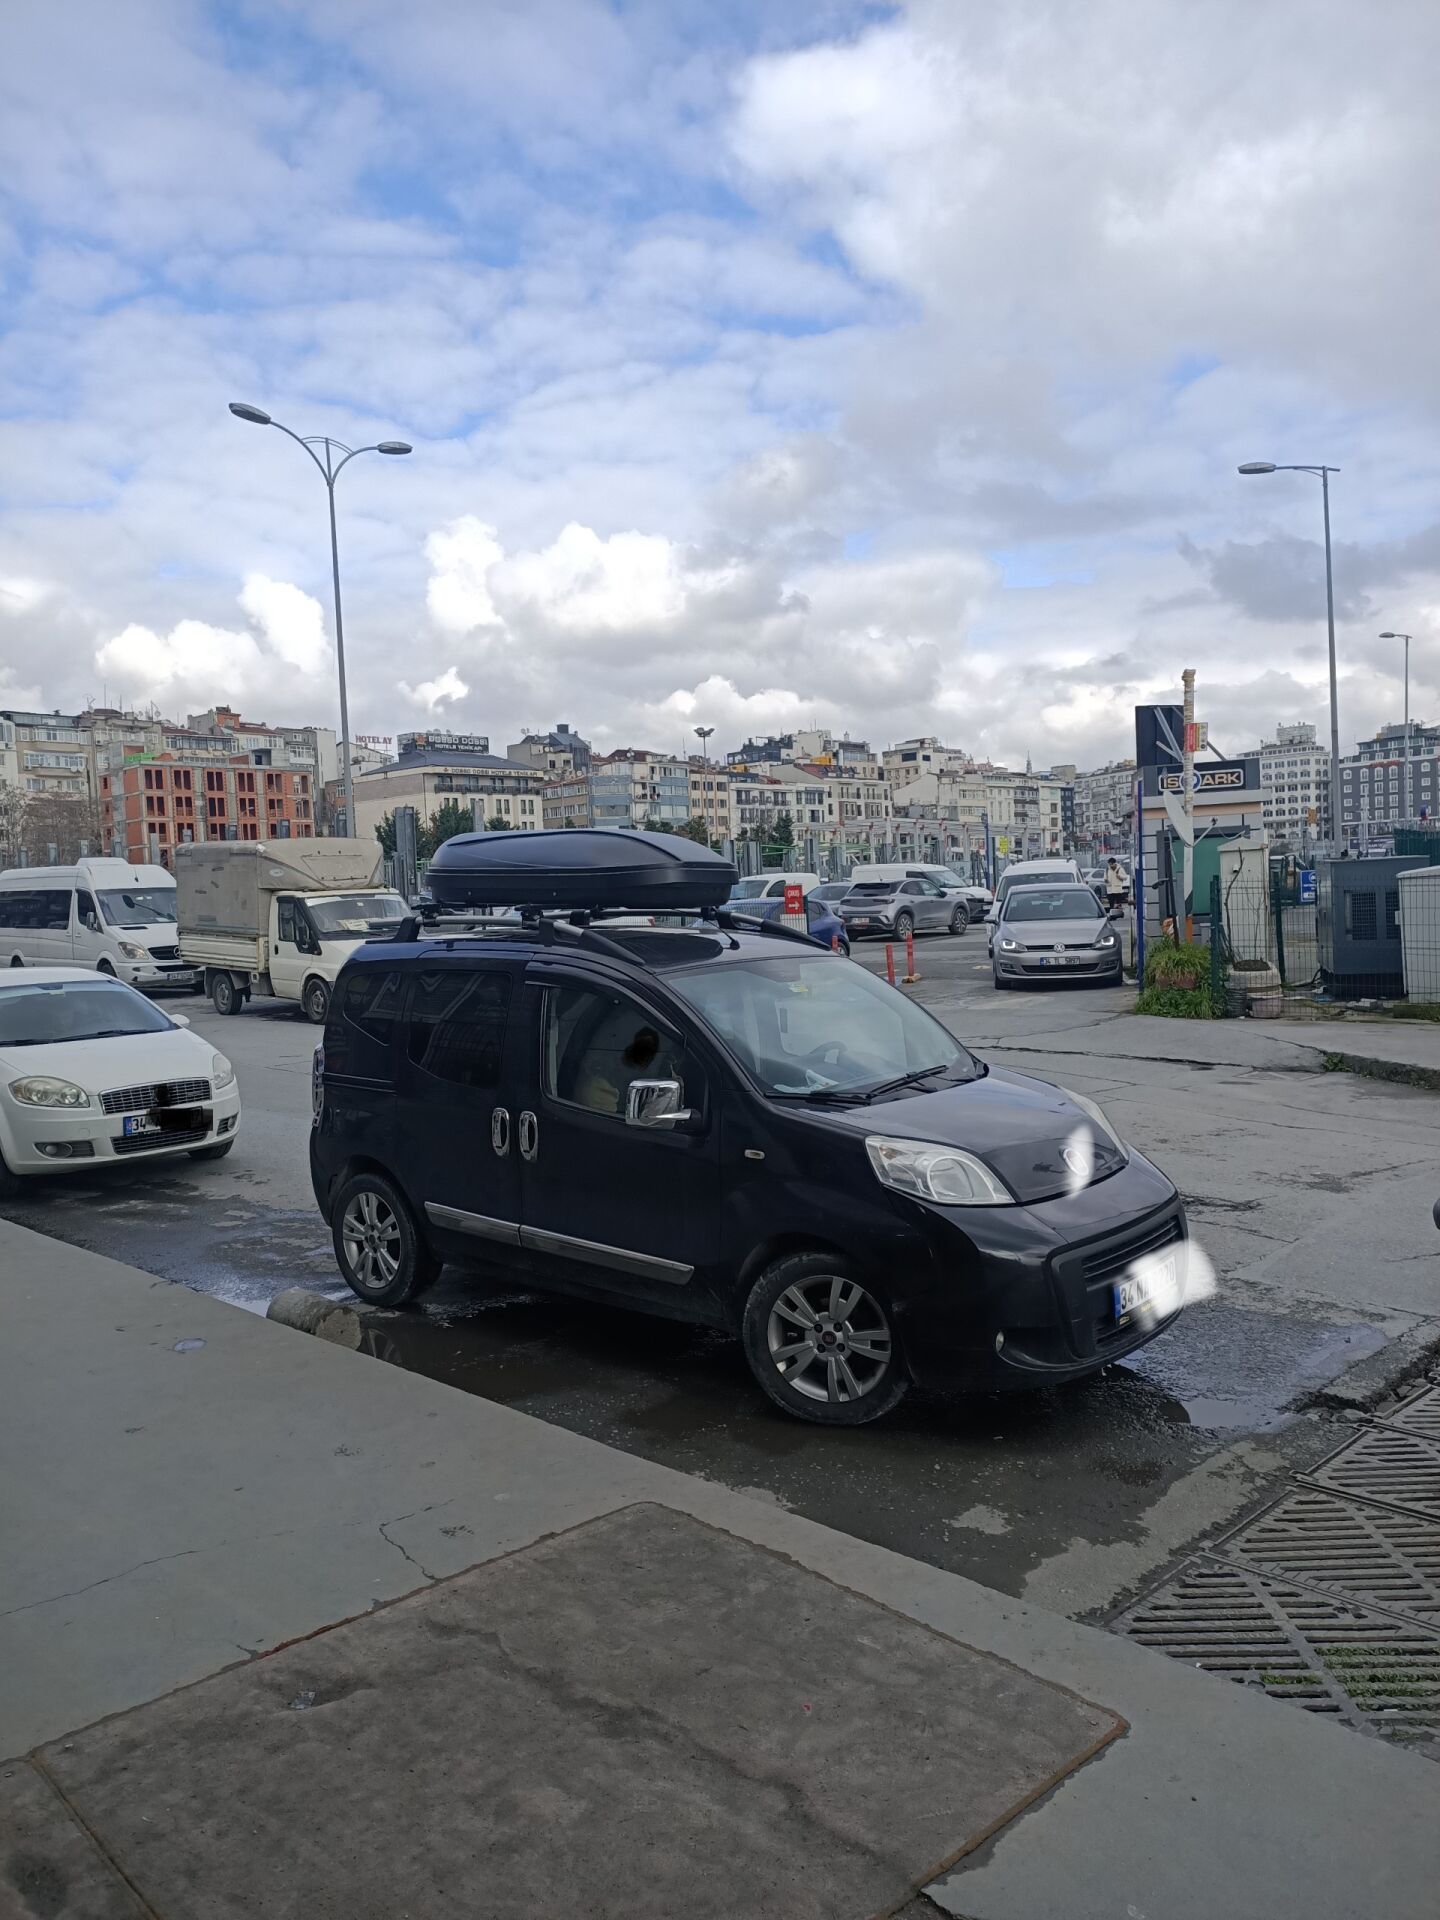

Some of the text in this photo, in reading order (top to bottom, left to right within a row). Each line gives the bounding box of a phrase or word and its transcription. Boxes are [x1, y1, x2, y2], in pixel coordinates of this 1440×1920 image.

[355, 735, 393, 745] HOTEL AY
[428, 735, 488, 746] DOSSO DOSSI
[132, 1118, 146, 1131] 34
[1121, 1283, 1135, 1310] 34
